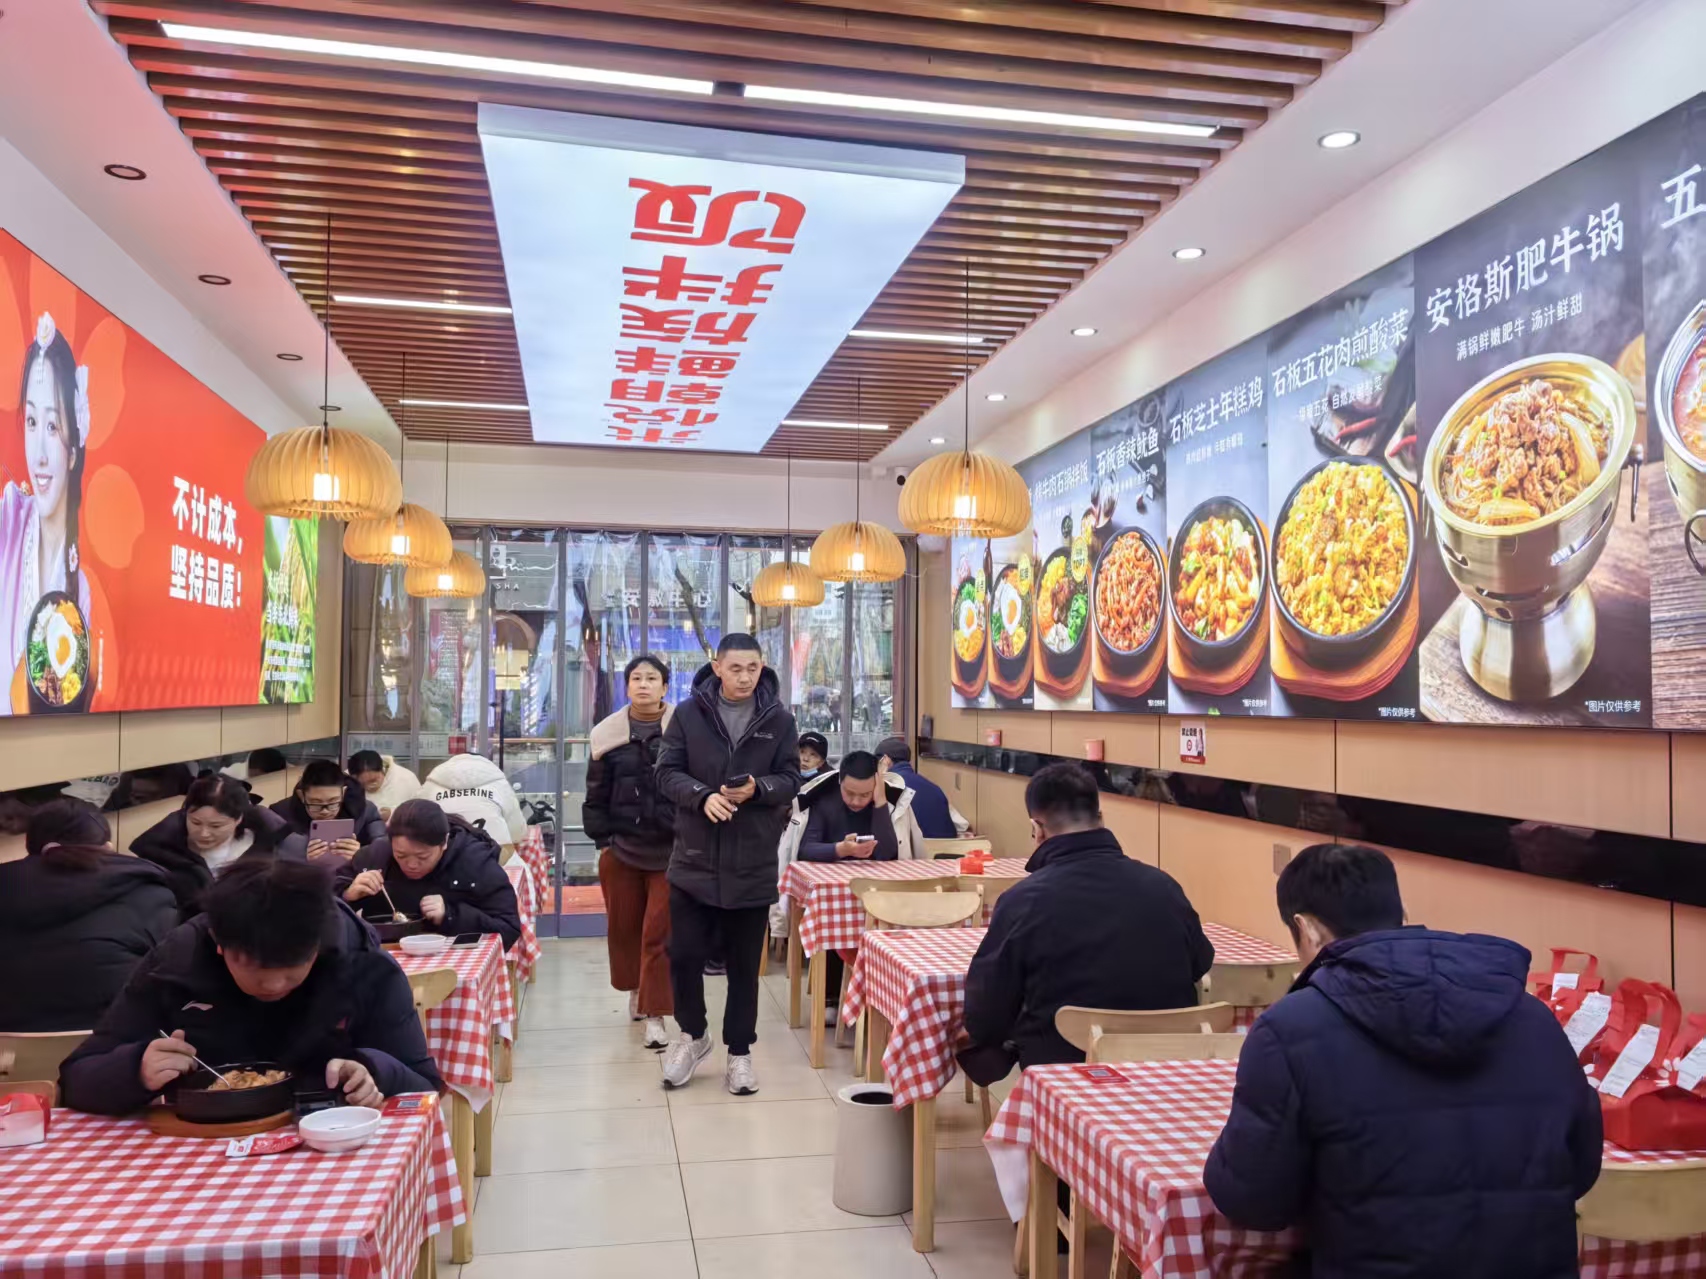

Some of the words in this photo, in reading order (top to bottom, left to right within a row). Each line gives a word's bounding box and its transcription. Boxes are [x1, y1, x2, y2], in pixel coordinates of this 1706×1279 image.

[1426, 201, 1624, 333] 安格斯肥牛锅
[1271, 306, 1409, 399] 石板五花肉煎酸菜
[1456, 319, 1525, 362] 满锅鲜嫩肥牛
[1531, 293, 1583, 332] 汤汁鲜甜
[1169, 375, 1264, 445] 石板芝士年糕鸡
[1096, 426, 1160, 476] 石板香辣鱿鱼
[172, 475, 243, 555] 不计成本，
[169, 544, 243, 609] 坚持品质！
[435, 787, 494, 801] GABSERINE
